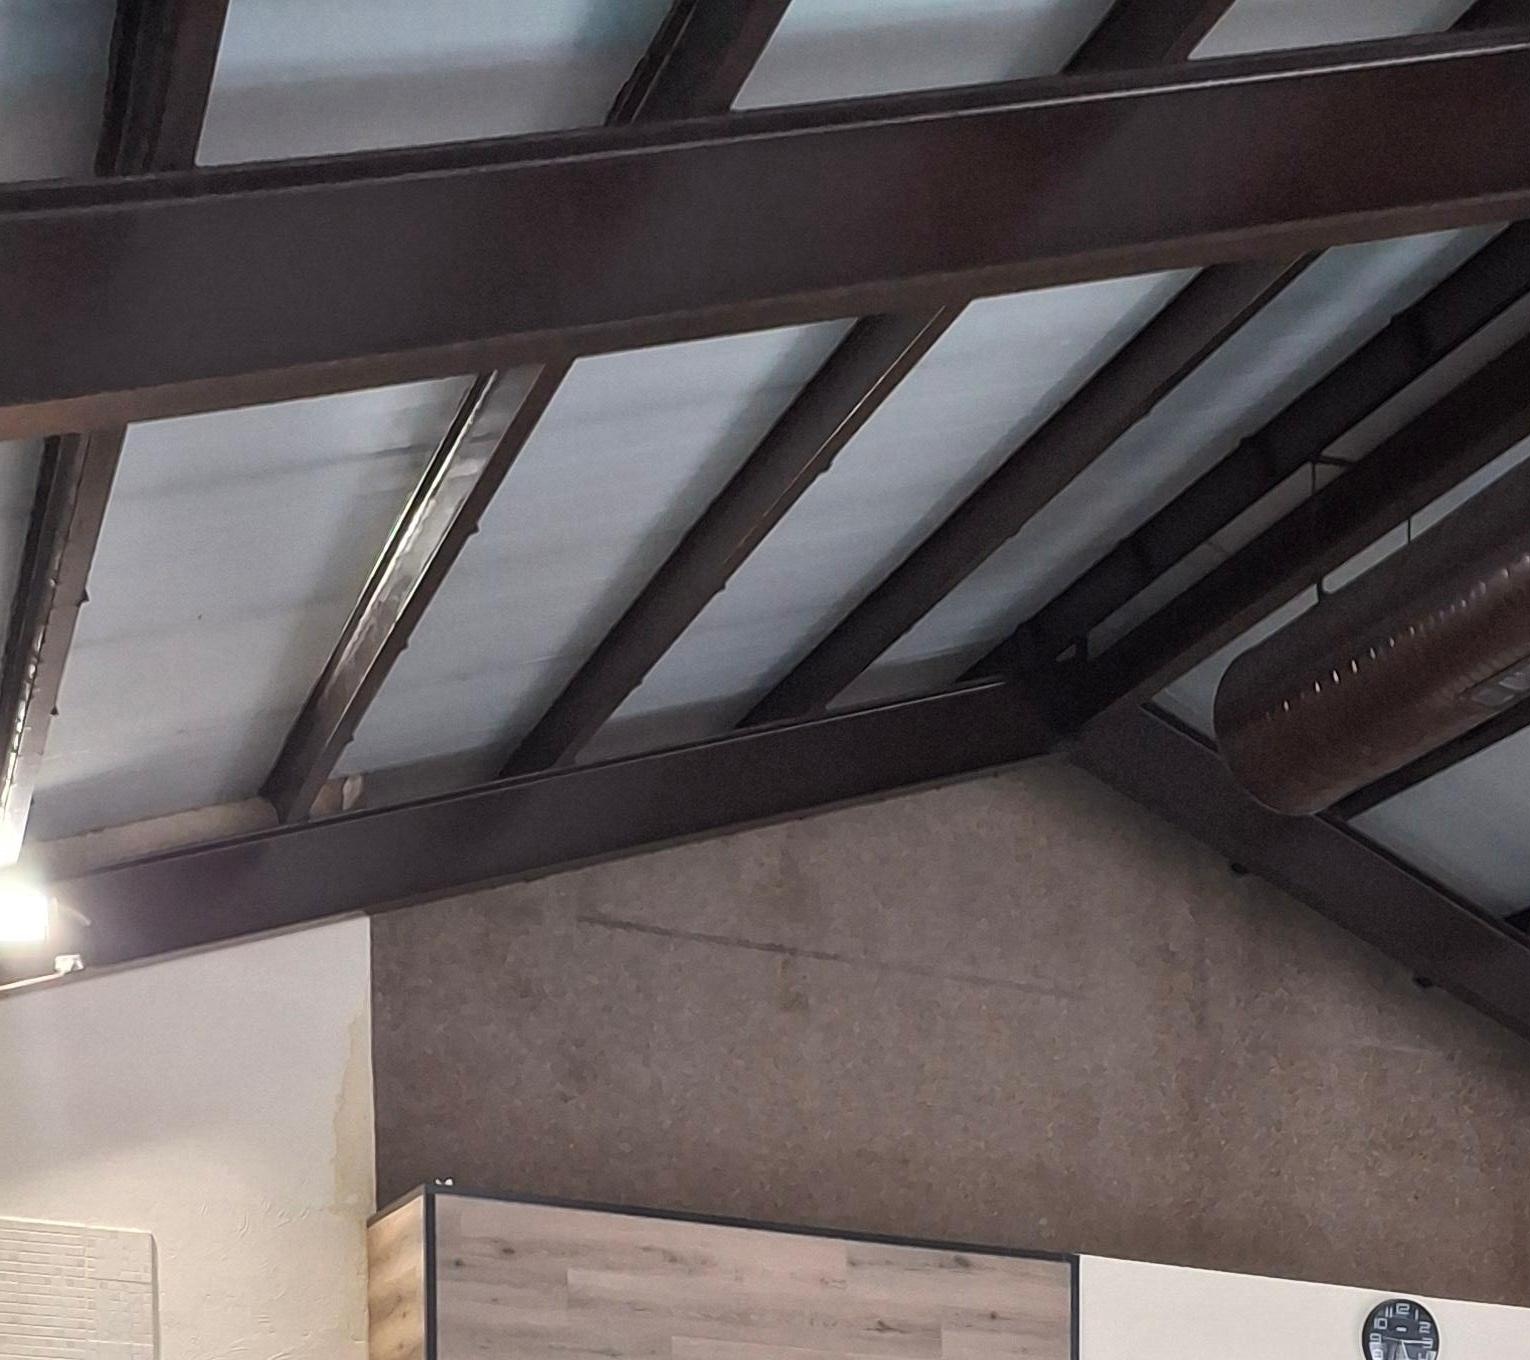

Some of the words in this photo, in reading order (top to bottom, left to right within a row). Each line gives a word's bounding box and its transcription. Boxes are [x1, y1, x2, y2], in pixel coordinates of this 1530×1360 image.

[1385, 1306, 1393, 1318] 11
[1414, 1308, 1419, 1321] 1
[1374, 1317, 1388, 1330] 10
[1419, 1321, 1431, 1334] 2
[1422, 1336, 1434, 1349] 3
